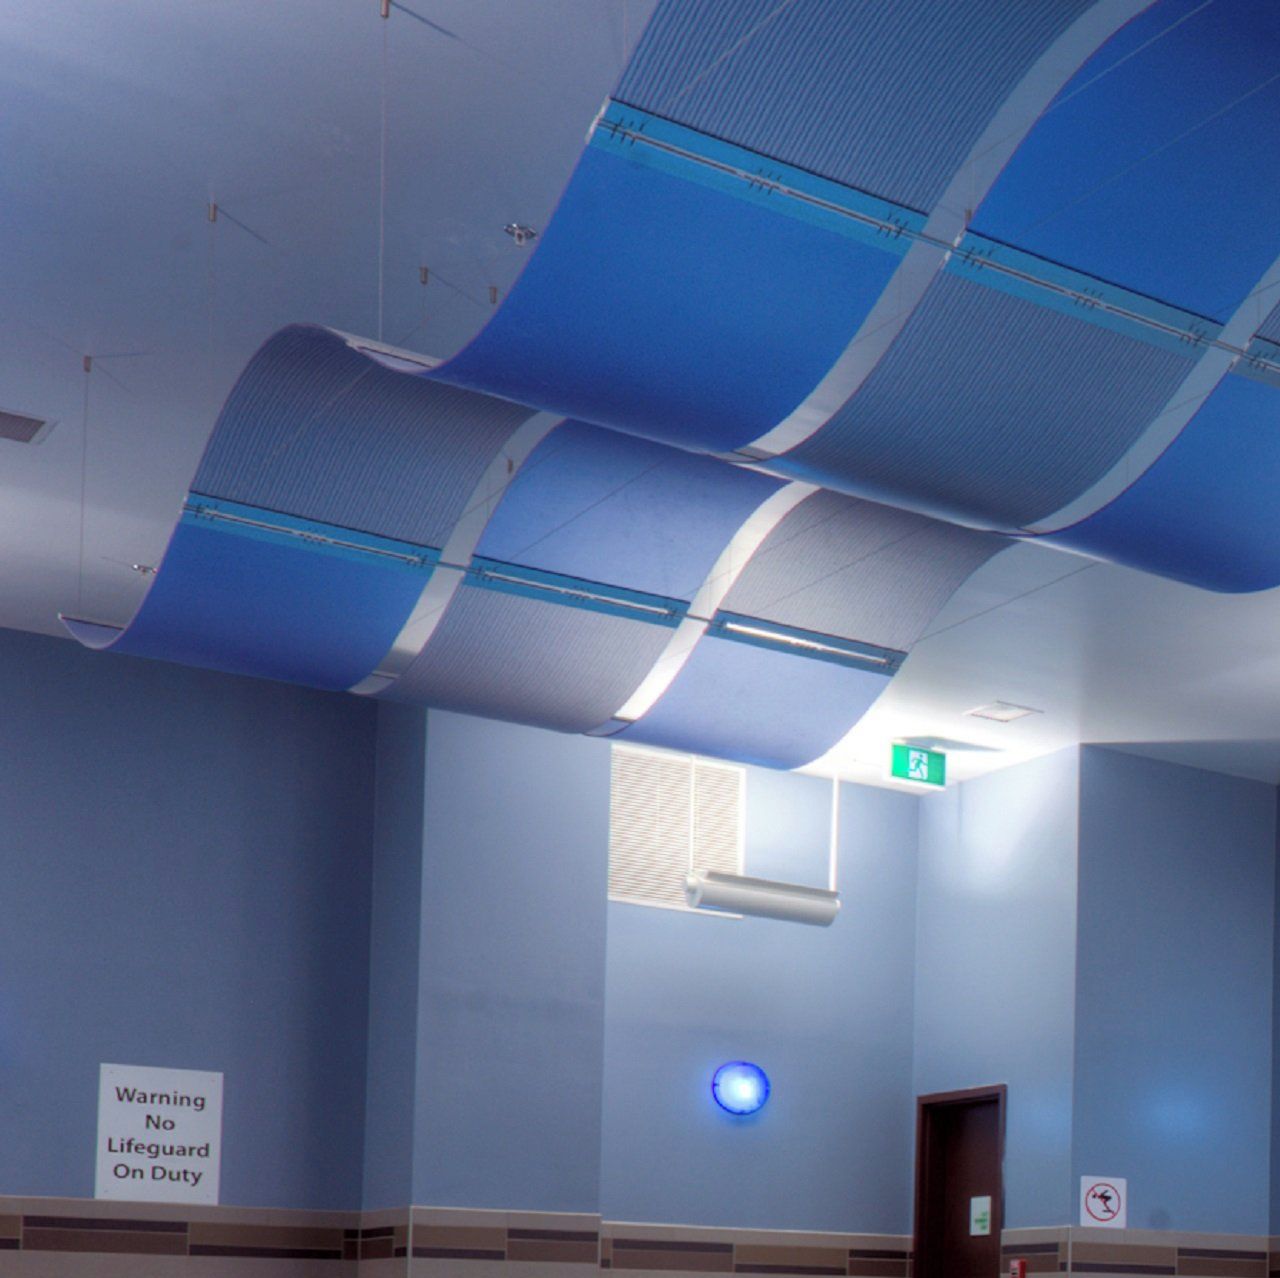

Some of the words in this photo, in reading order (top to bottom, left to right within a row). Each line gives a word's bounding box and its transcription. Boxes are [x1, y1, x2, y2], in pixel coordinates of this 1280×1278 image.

[115, 1086, 206, 1112] Warning
[145, 1114, 175, 1131] No
[107, 1137, 210, 1159] Lifeguard
[113, 1163, 144, 1180] On
[151, 1165, 203, 1187] Duty
